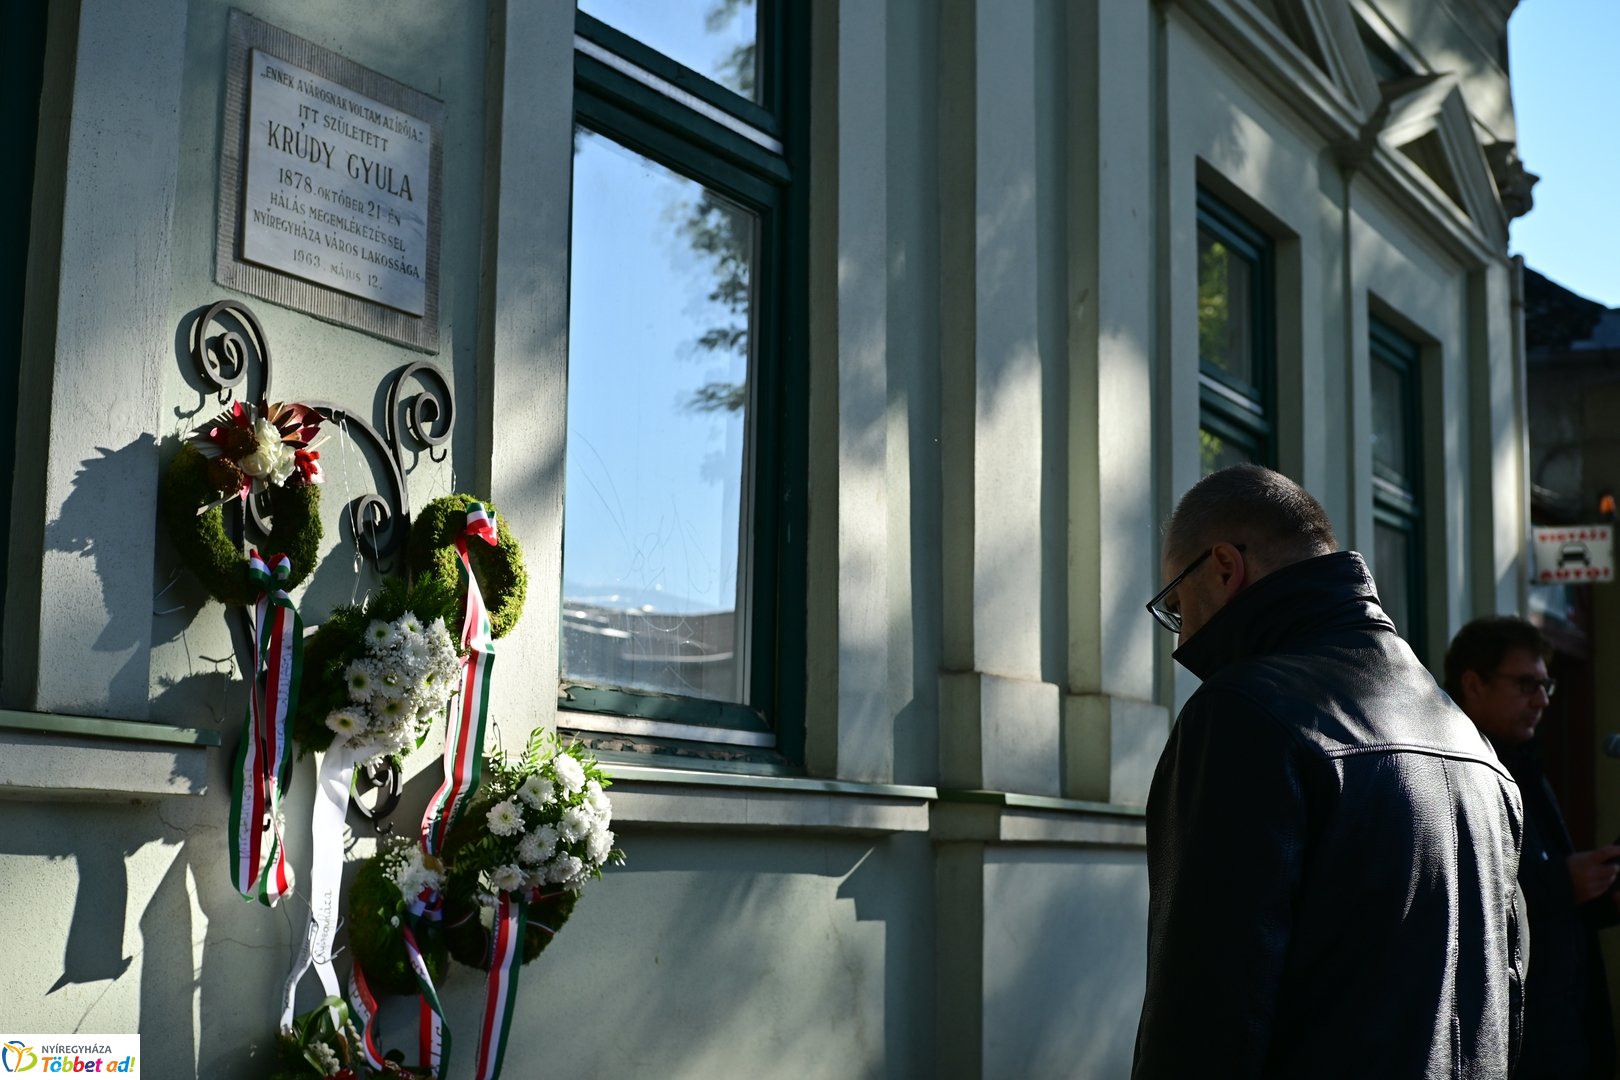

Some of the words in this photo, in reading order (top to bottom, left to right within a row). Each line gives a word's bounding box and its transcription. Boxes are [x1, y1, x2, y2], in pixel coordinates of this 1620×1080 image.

[297, 80, 303, 92] A
[304, 80, 347, 111] VÁROSNAK
[348, 101, 381, 125] VOLTAM
[383, 116, 394, 131] AZ
[299, 104, 319, 124] ITT
[323, 114, 388, 152] SZÜLETETT
[268, 120, 335, 169] KRÚDY
[347, 153, 413, 202] GYULA
[270, 190, 306, 216] HÁLÁS
[309, 206, 406, 252] MEGEMLÉKEZÉSSEL
[317, 187, 364, 214] OKTÓBER
[253, 208, 321, 244] NYÍREGYHÁZA
[325, 231, 359, 257] VÁROS
[361, 247, 420, 279] LAKOSSÁGA
[330, 262, 361, 281] MÁJUS
